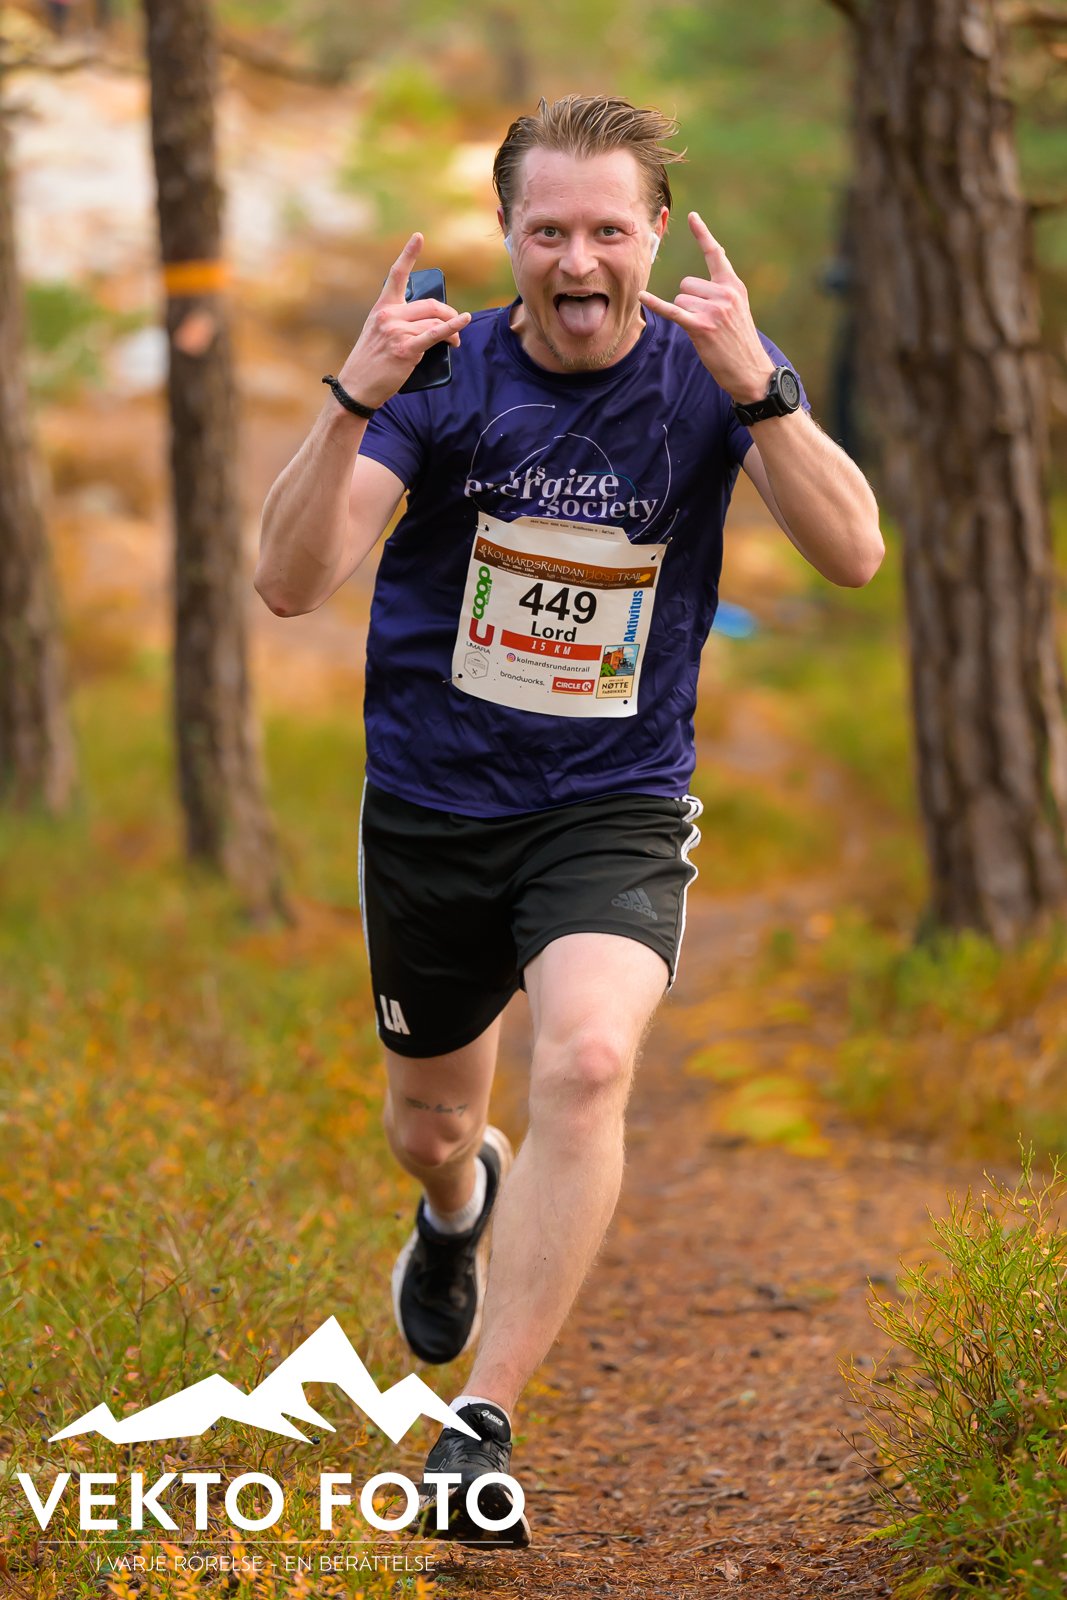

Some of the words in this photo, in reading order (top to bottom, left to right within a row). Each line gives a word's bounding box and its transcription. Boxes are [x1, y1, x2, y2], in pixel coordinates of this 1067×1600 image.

[544, 496, 659, 523] society
[473, 565, 492, 619] coop
[518, 582, 598, 625] 449
[623, 590, 644, 643] Aktivitus
[530, 620, 578, 643] Lord
[516, 656, 591, 673] kolmardsrundantrail
[555, 680, 582, 690] CIRCLE
[582, 682, 592, 691] K
[602, 681, 629, 690] NØTTE
[611, 897, 658, 921] adidas
[379, 993, 411, 1036] LA
[487, 1414, 505, 1427] asics
